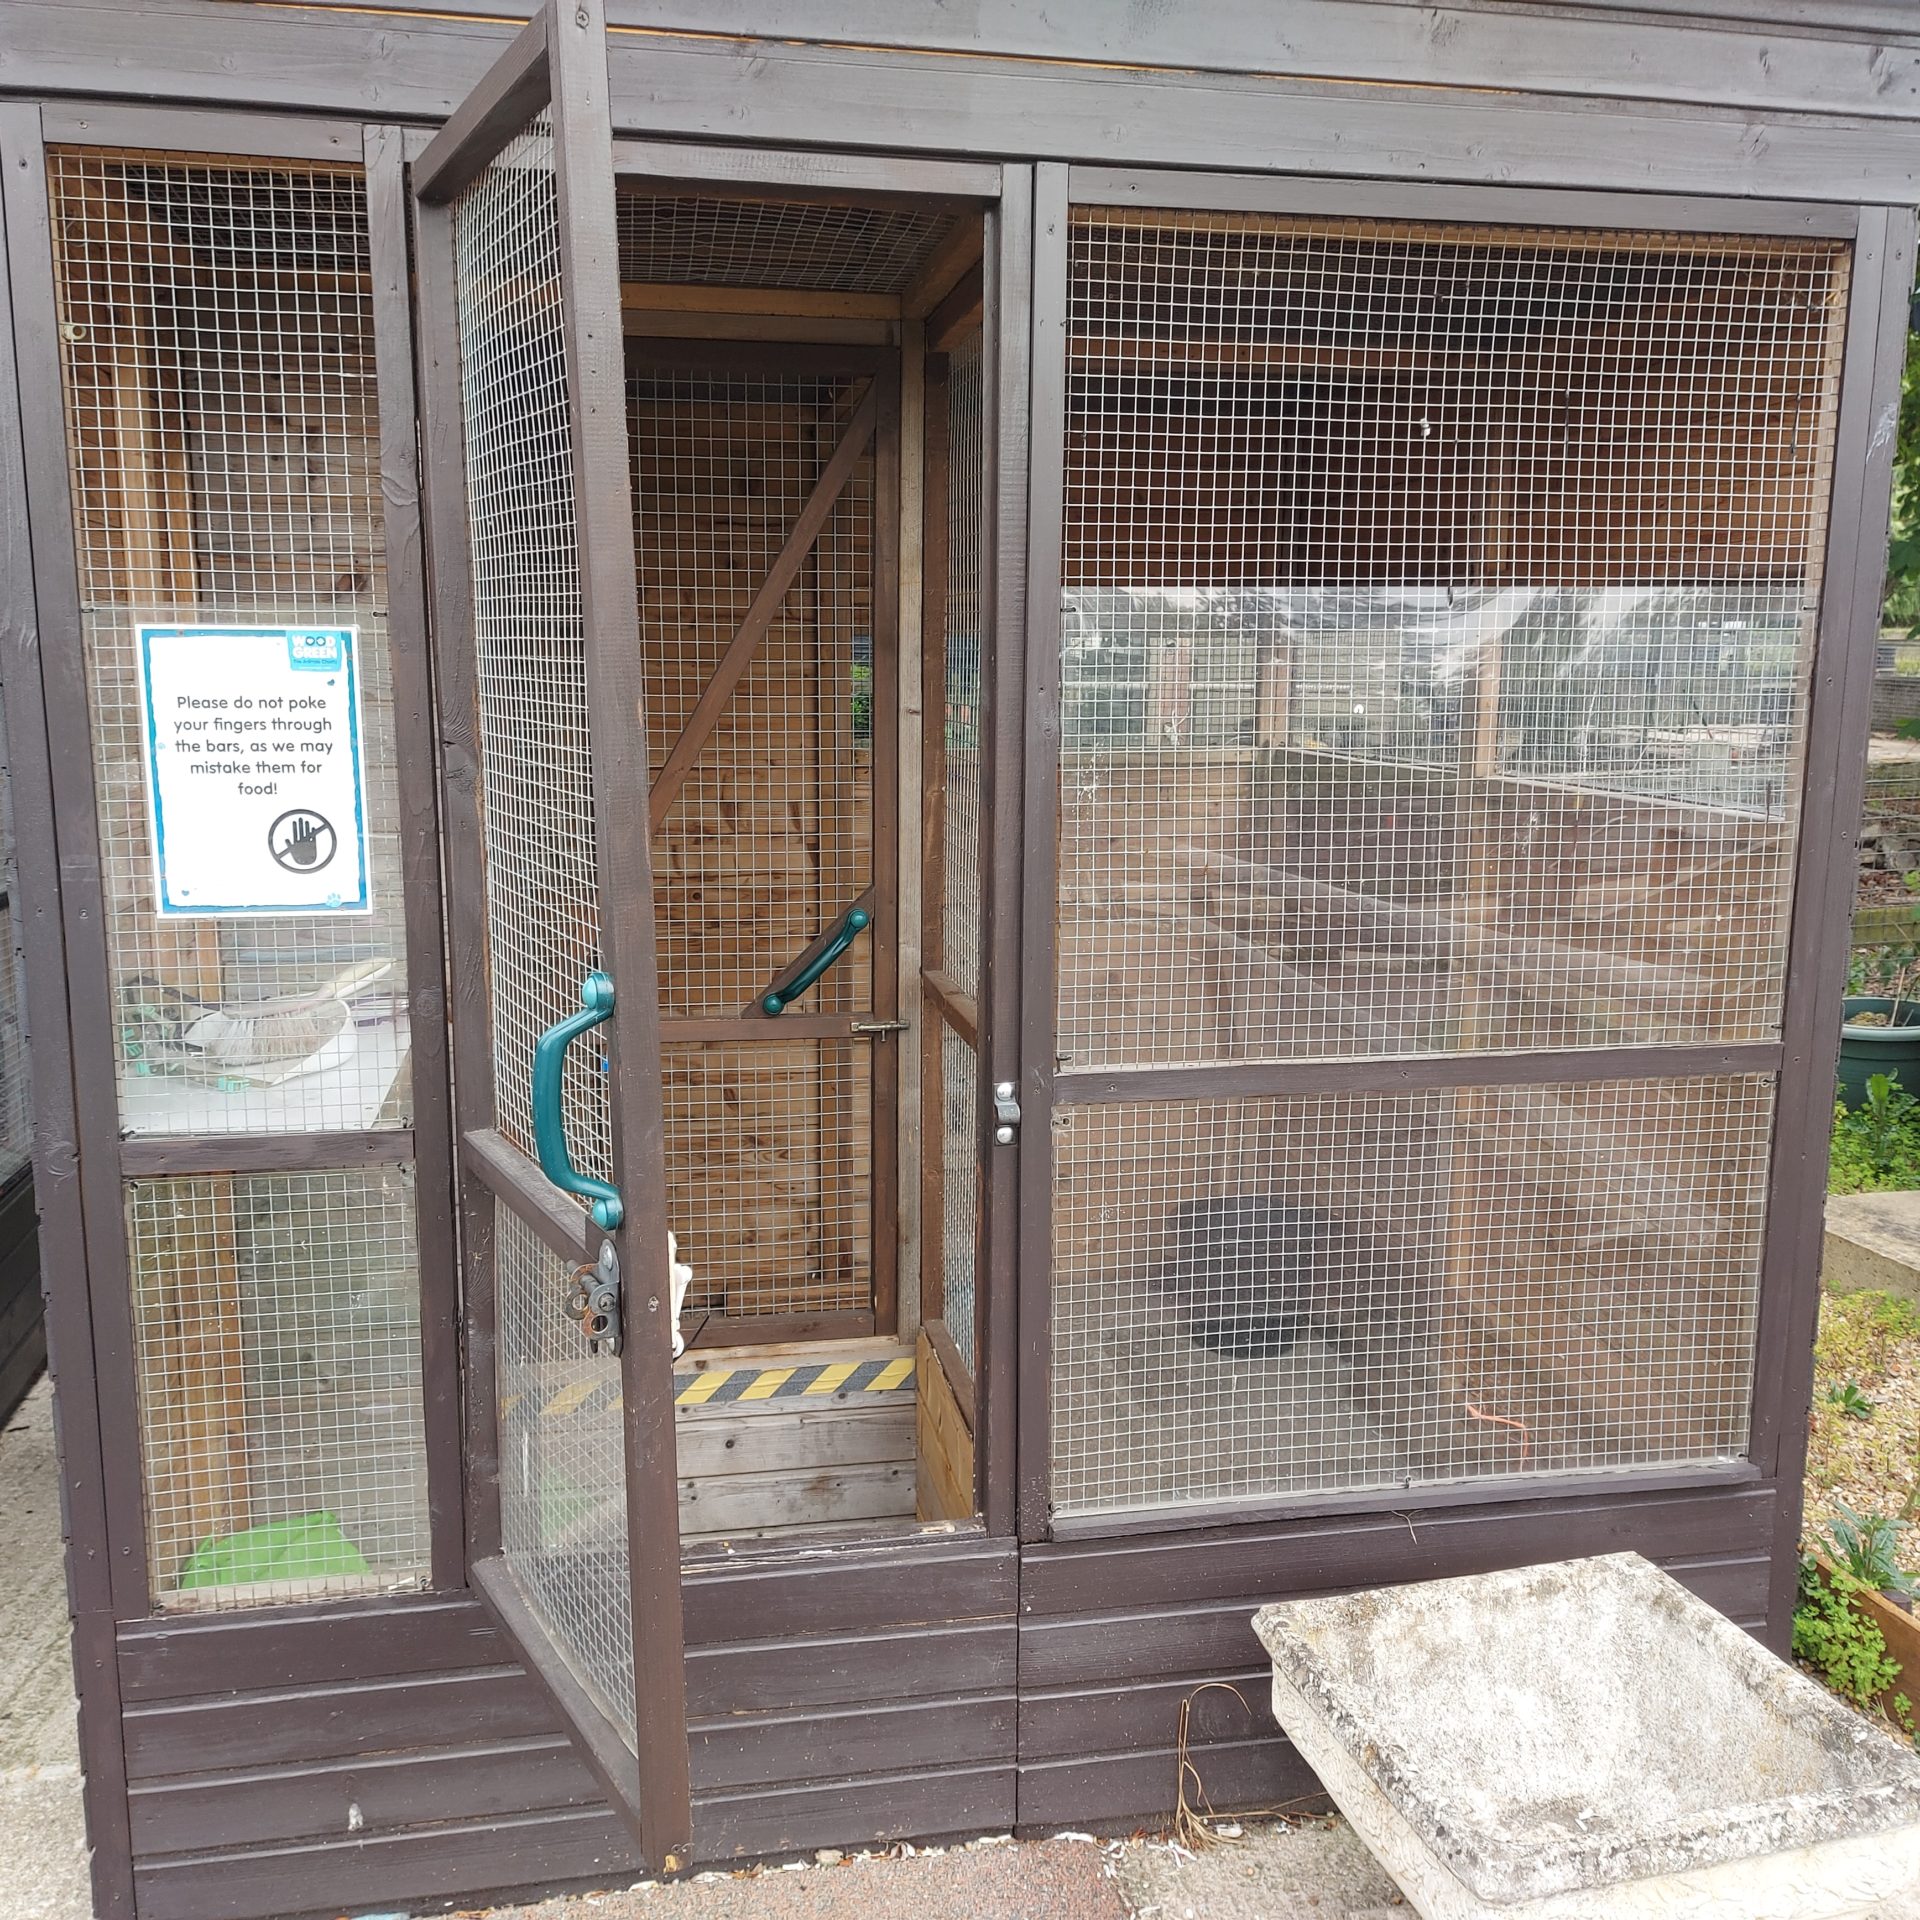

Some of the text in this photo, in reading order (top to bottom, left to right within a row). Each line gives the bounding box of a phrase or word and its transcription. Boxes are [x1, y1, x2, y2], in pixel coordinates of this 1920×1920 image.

[292, 634, 336, 647] WOOD
[292, 646, 338, 659] GREEN
[177, 695, 326, 712] Please do not poke
[173, 717, 332, 734] your fingers through
[175, 739, 333, 756] the bars, as we may
[190, 760, 323, 774] mistake them for
[237, 781, 278, 795] food!
